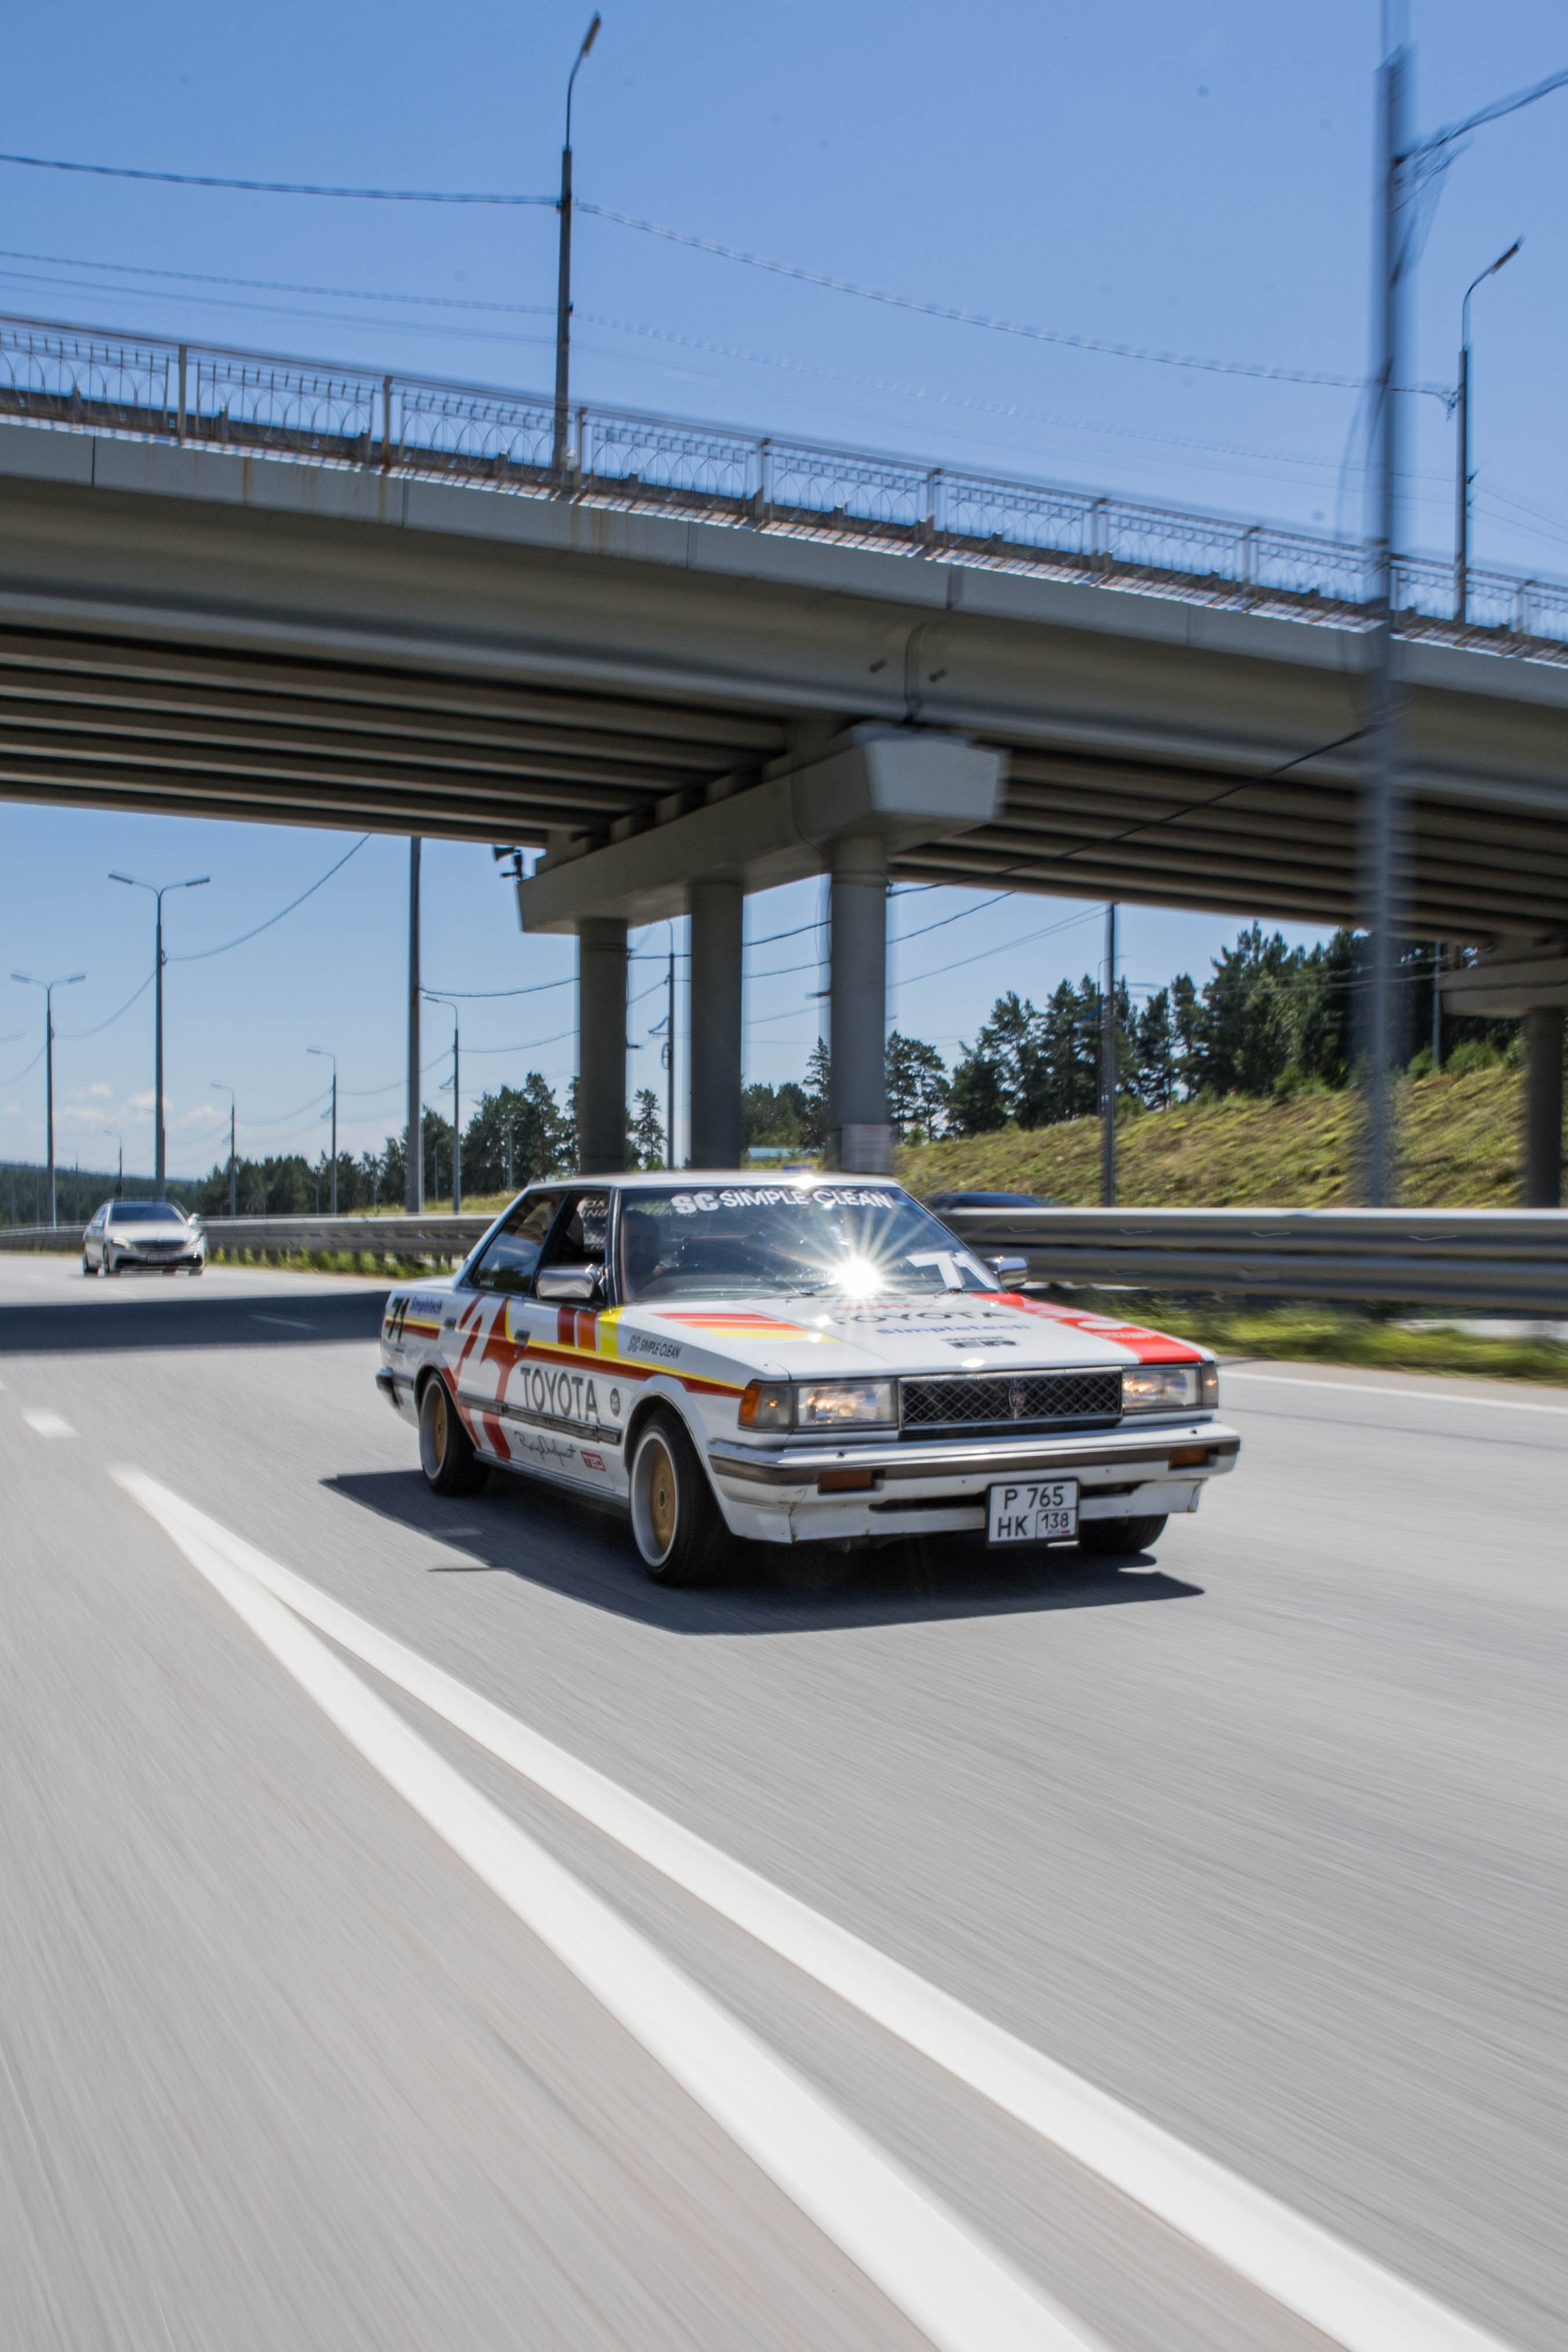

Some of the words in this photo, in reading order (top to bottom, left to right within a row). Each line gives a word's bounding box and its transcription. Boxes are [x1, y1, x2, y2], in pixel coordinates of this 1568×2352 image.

[671, 1191, 719, 1214] SC
[719, 1190, 810, 1207] SIMPLE
[812, 1190, 892, 1208] CLEAN
[905, 1251, 999, 1290] 71
[387, 1297, 410, 1344] 71
[832, 1311, 1016, 1325] TOYOTA
[627, 1335, 641, 1353] SC
[639, 1338, 662, 1355] SIMPLE
[659, 1343, 682, 1360] CLEAN
[521, 1366, 601, 1427] TOYOTA
[1004, 1488, 1018, 1510] P
[1027, 1485, 1065, 1509] 765
[997, 1515, 1028, 1538] HK
[1041, 1512, 1069, 1529] 138
